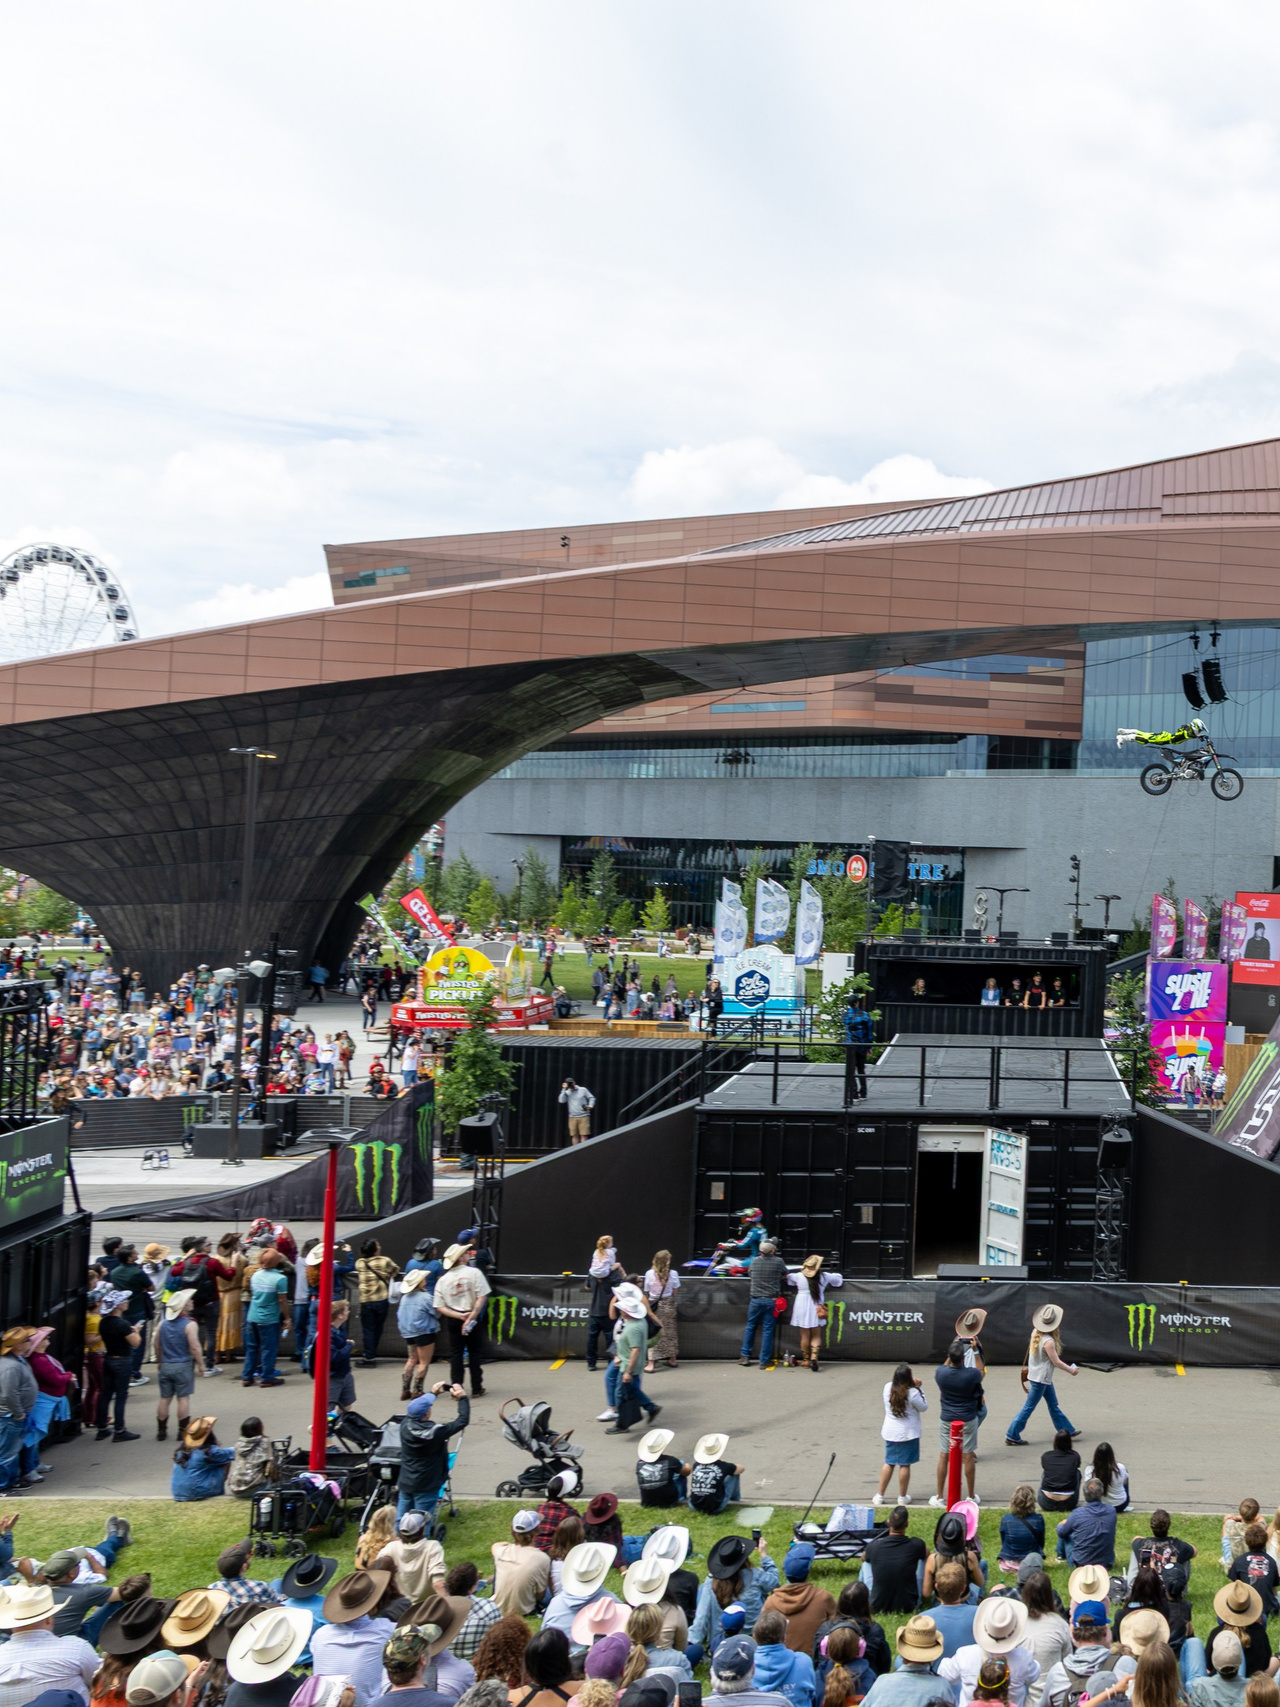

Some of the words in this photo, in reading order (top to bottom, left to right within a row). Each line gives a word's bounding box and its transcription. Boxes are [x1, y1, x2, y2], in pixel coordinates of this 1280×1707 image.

[748, 958, 772, 972] CREAM
[1165, 971, 1212, 994] SLUSH
[8, 1153, 53, 1177] MONSTER
[522, 1305, 589, 1320] MONSTE
[849, 1309, 924, 1324] MONSTER
[1160, 1312, 1232, 1328] MONSTER
